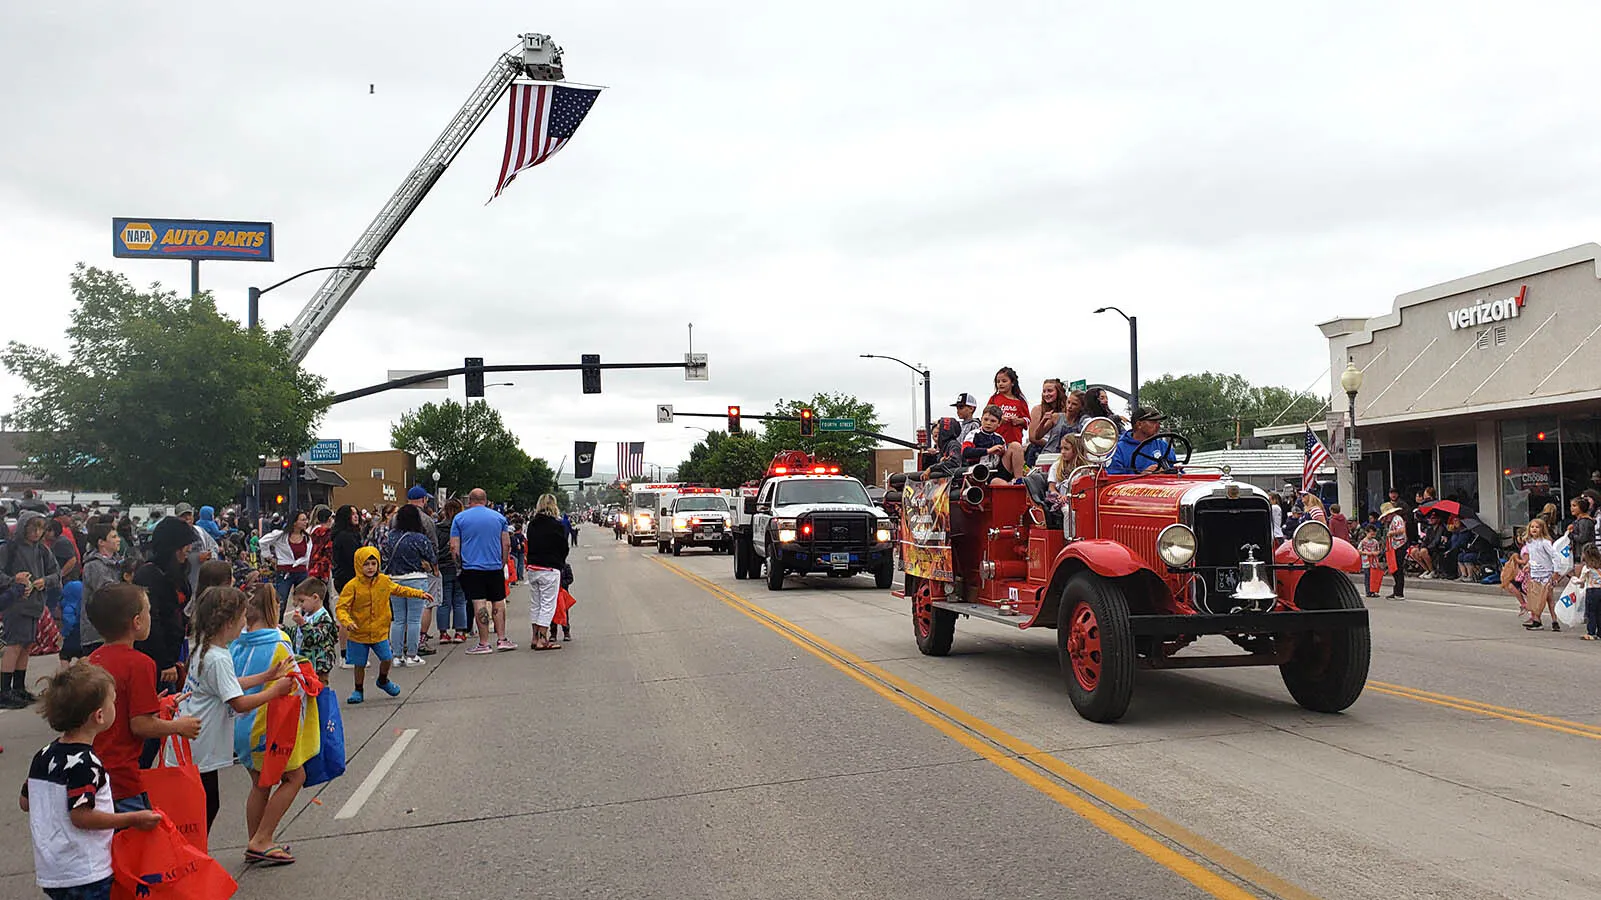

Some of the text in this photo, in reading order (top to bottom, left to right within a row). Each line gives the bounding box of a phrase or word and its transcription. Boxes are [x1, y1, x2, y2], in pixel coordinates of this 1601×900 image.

[528, 36, 540, 46] T1
[127, 230, 151, 242] NAPA
[160, 229, 265, 247] AUTO PARTS
[1448, 297, 1518, 330] verizon
